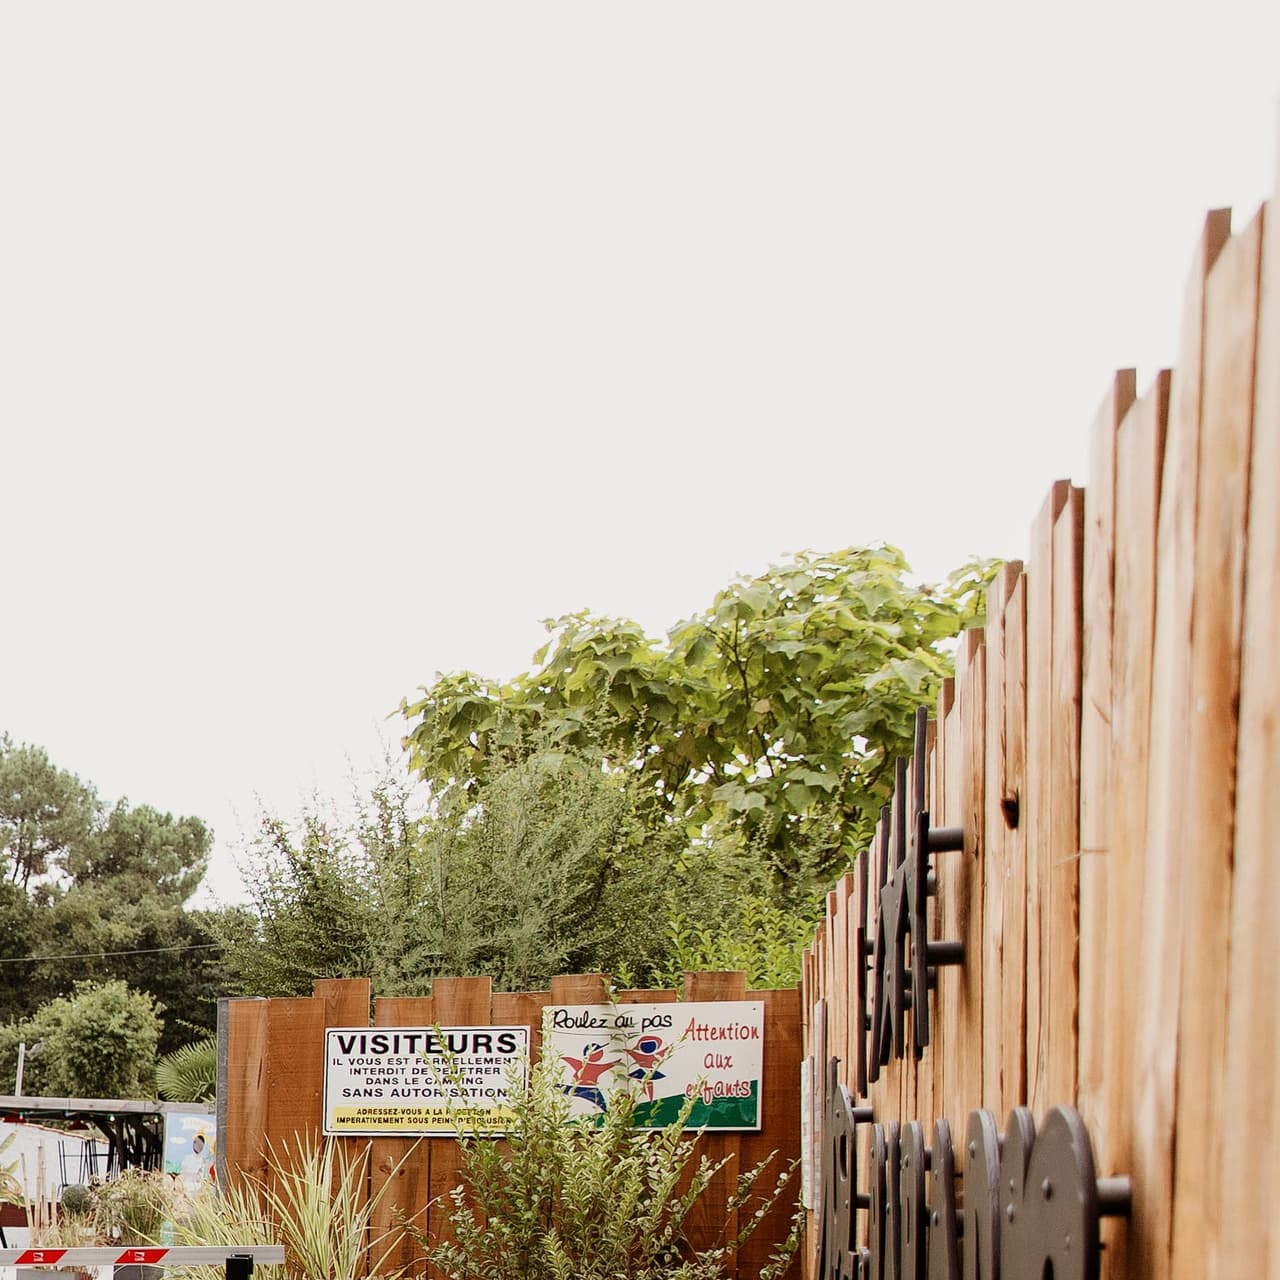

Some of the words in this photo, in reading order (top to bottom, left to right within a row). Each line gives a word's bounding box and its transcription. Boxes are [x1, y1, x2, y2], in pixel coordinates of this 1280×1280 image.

[553, 1009, 608, 1029] Roulez
[615, 1015, 634, 1028] au
[642, 1015, 673, 1032] pas
[684, 1017, 759, 1041] Attention
[337, 1033, 517, 1055] VISITEURS
[333, 1058, 343, 1066] IL
[348, 1058, 382, 1066] VOUS
[704, 1053, 734, 1069] aux
[425, 1077, 483, 1085] CMING
[342, 1088, 384, 1098] SANS
[391, 1088, 508, 1098] AUTORSATION
